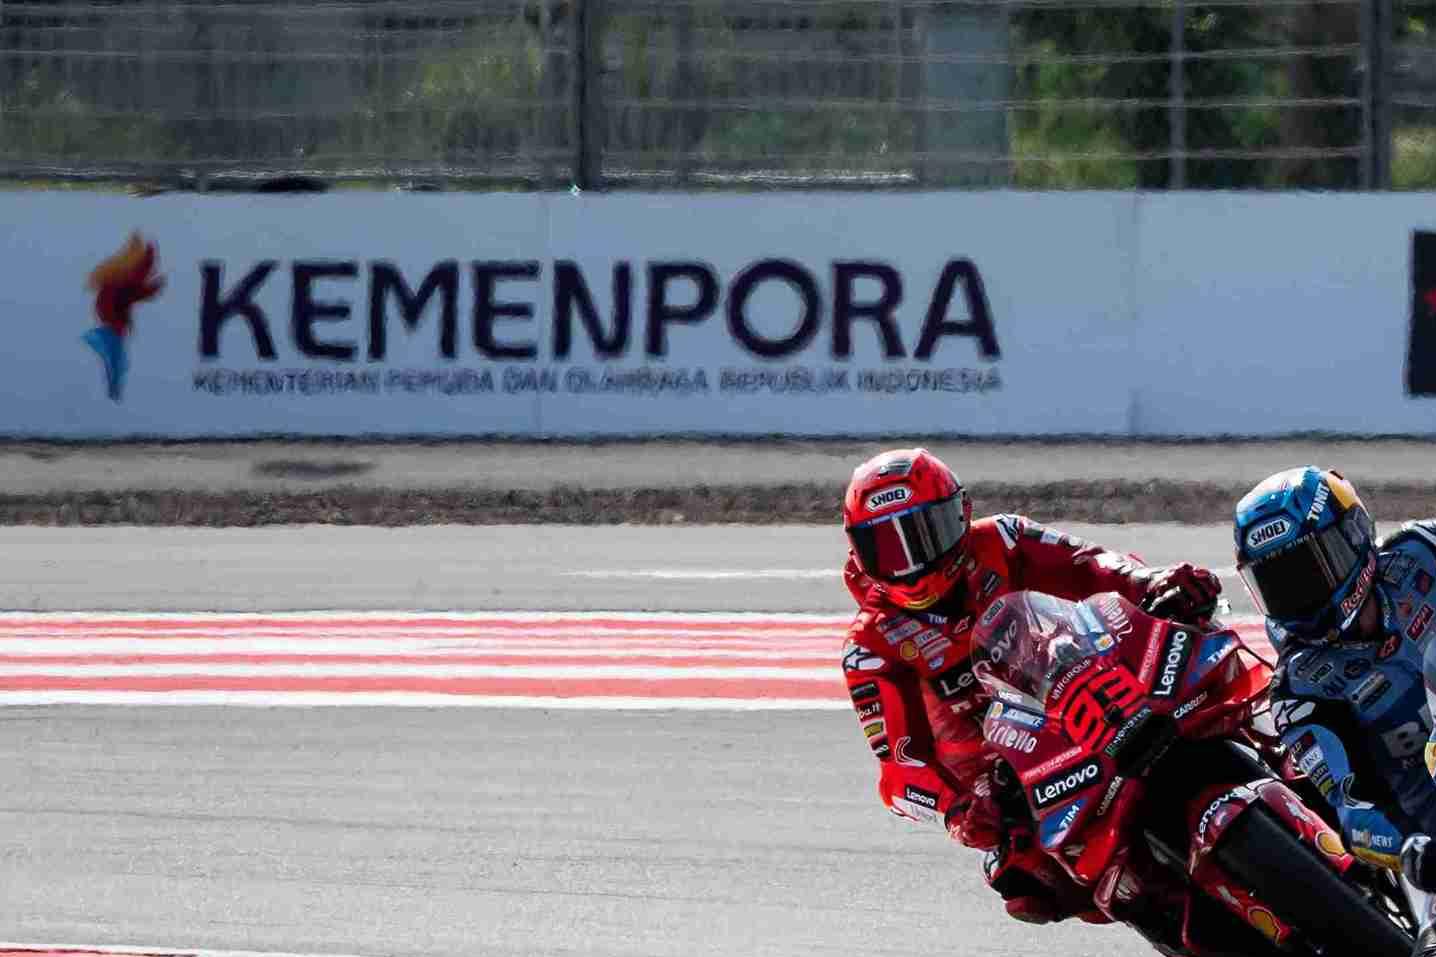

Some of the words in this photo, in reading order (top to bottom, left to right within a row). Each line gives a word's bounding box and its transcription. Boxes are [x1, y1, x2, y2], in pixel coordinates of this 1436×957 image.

[199, 259, 1000, 362] KEMENPORA
[192, 367, 380, 394] KEMENTERIAN
[502, 367, 557, 394] DAN
[857, 367, 1003, 393] INDONESIA
[870, 488, 906, 507] SHOEI
[1251, 521, 1286, 545] SHOEI
[1154, 631, 1188, 695] Lenovo
[1063, 664, 1142, 748] 93
[906, 787, 936, 807] Lenovo
[1035, 764, 1099, 804] Lenovo
[1058, 804, 1080, 829] TIM
